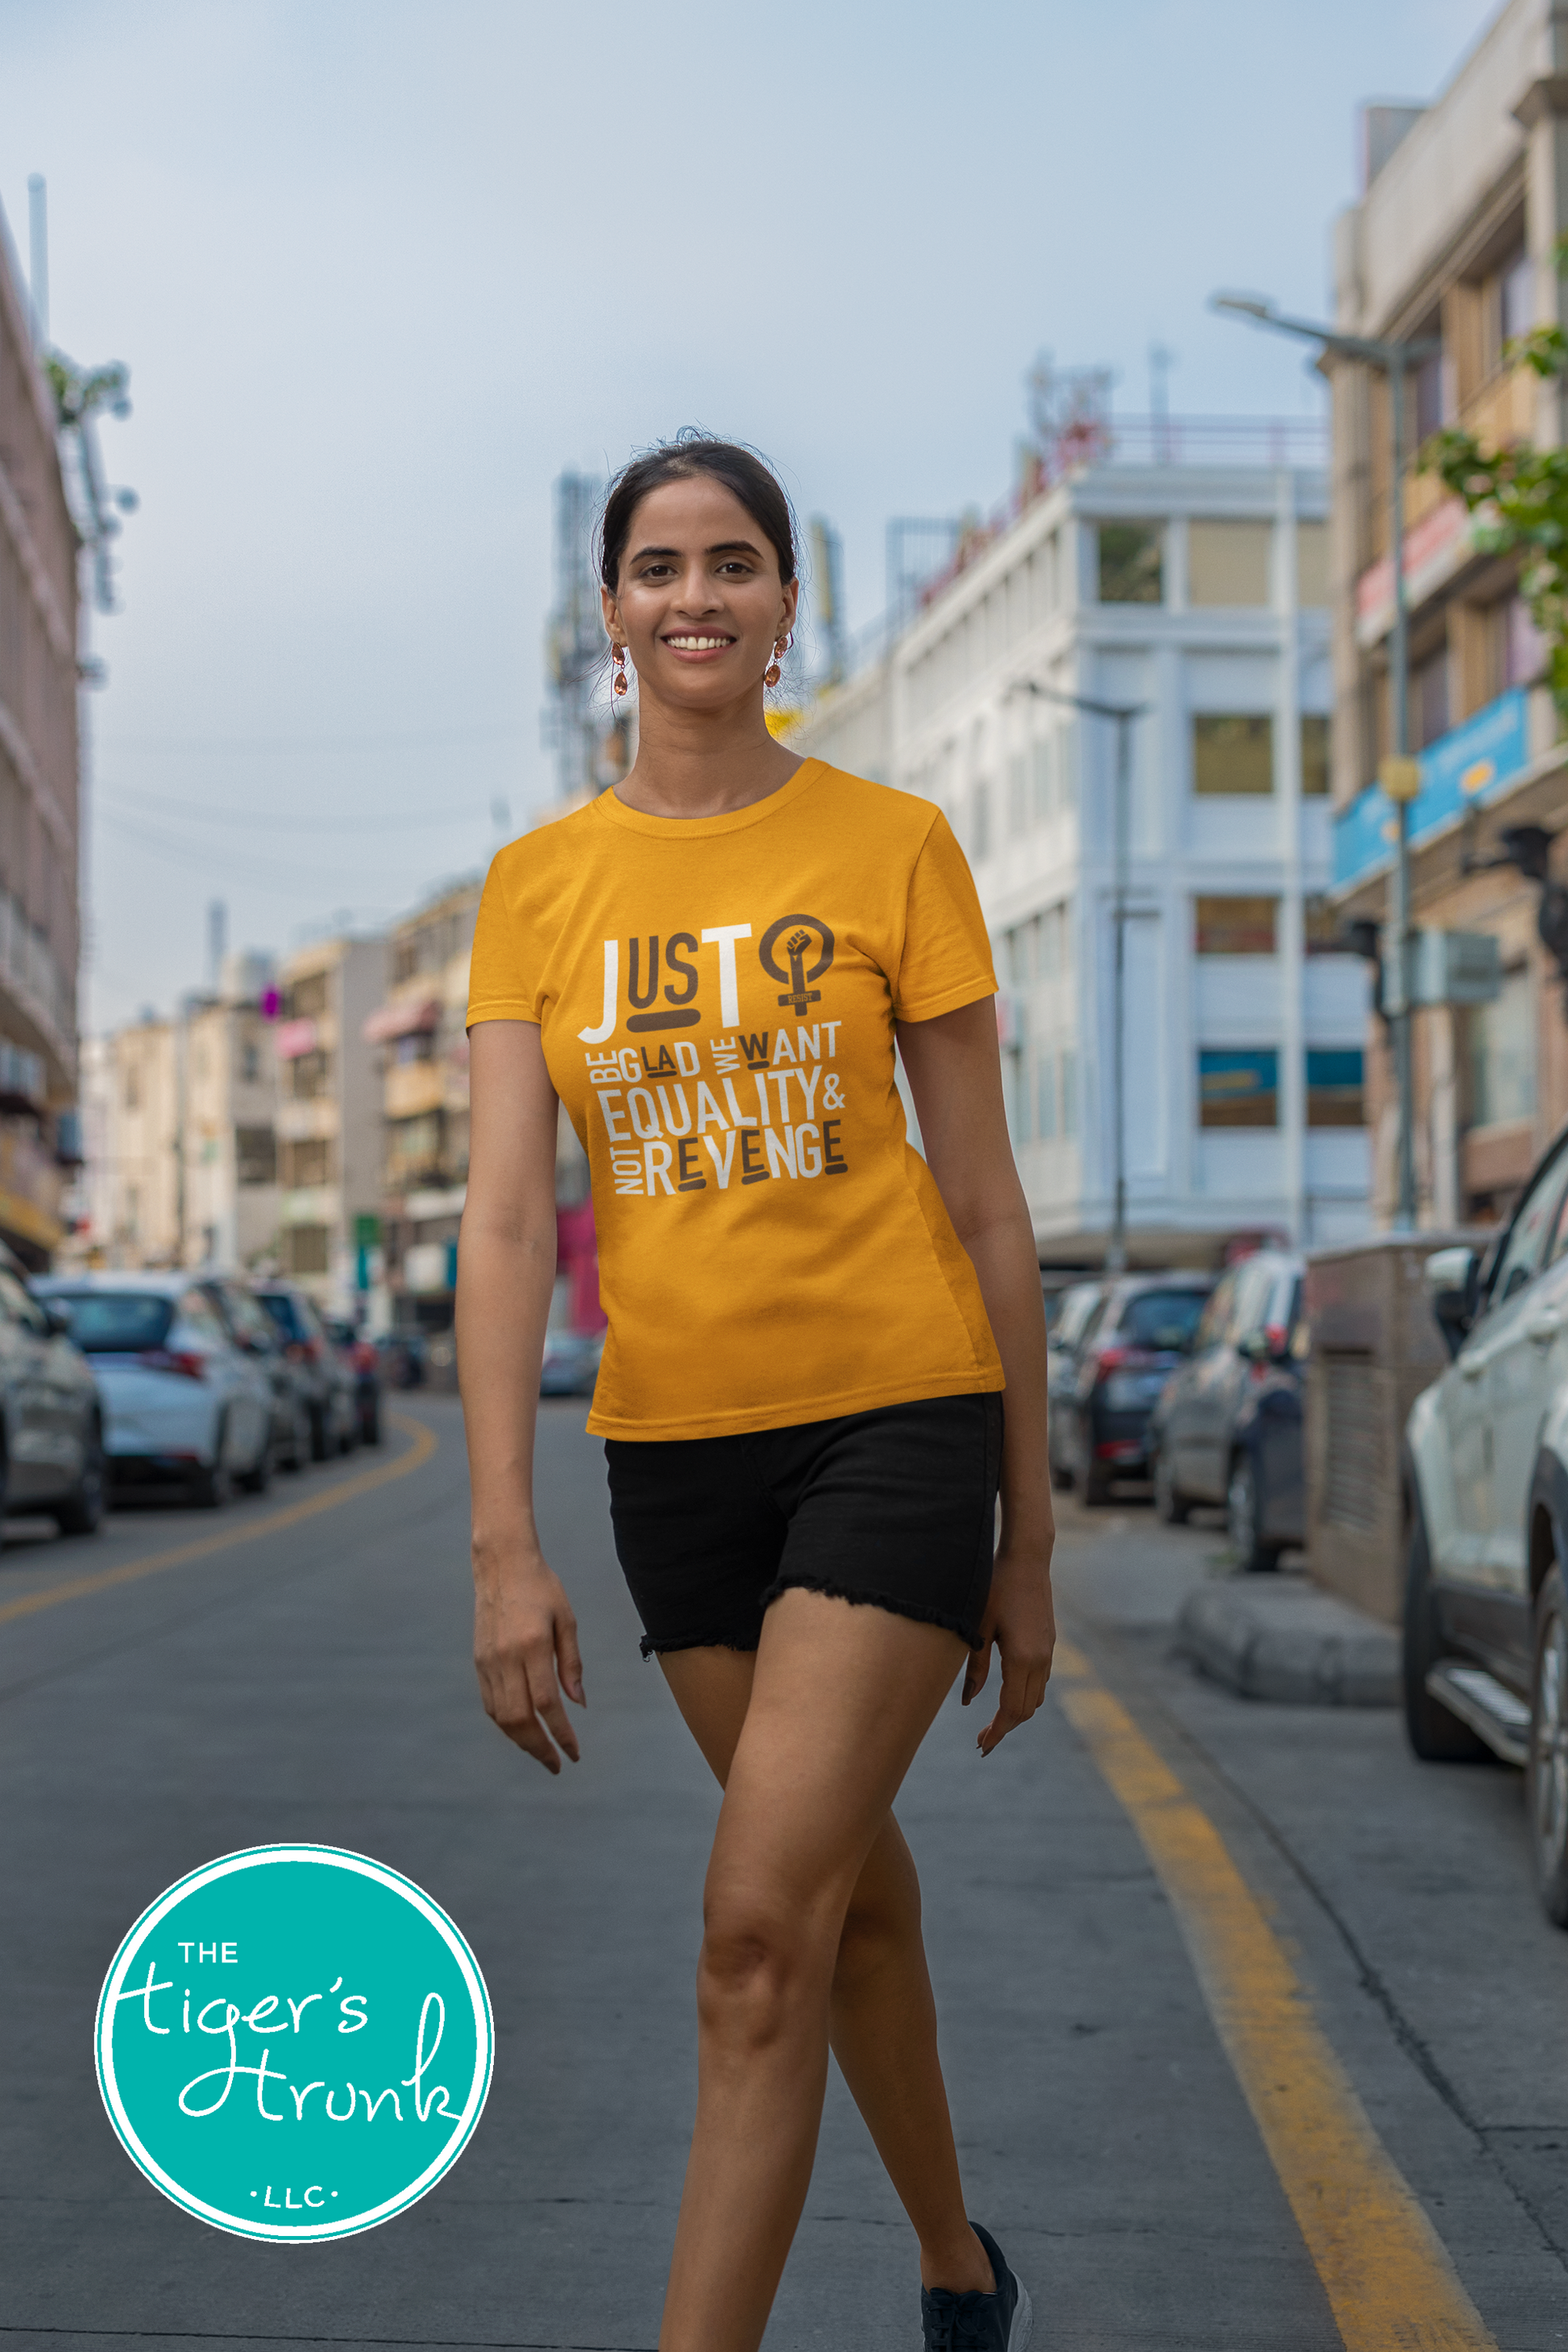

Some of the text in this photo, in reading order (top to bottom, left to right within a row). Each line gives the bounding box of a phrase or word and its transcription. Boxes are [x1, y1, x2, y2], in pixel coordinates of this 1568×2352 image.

[577, 923, 752, 1044] JUST
[787, 993, 813, 1004] RESIST
[585, 1020, 842, 1084] BE GLAD WE WANT
[609, 1119, 844, 1197] NOT REVENGE
